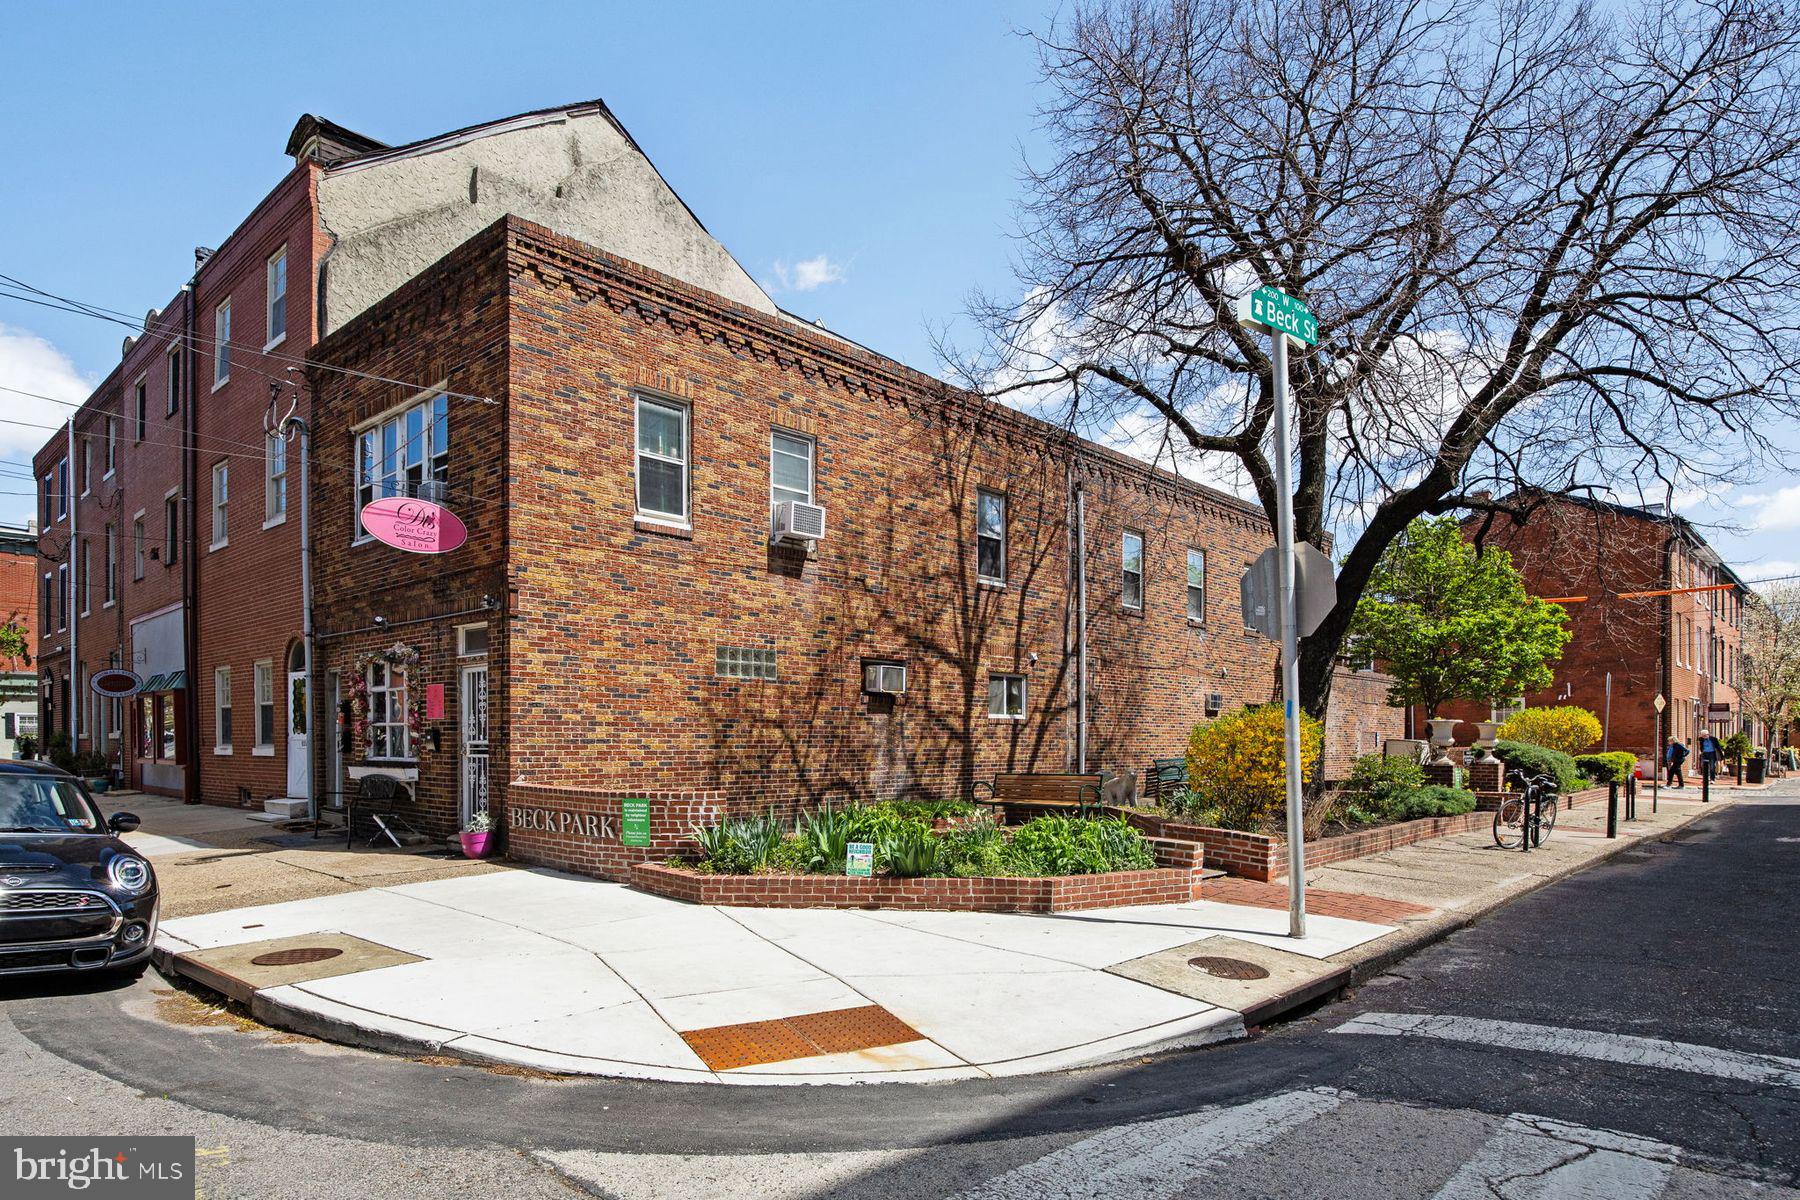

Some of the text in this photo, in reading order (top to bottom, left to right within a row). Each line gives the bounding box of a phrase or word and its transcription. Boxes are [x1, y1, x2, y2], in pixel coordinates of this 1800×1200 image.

[1267, 289, 1304, 313] 200 W 100
[1267, 300, 1316, 341] Beck St
[393, 524, 438, 538] Color Crazy
[401, 538, 429, 549] Salon
[511, 807, 615, 839] BECK PARK
